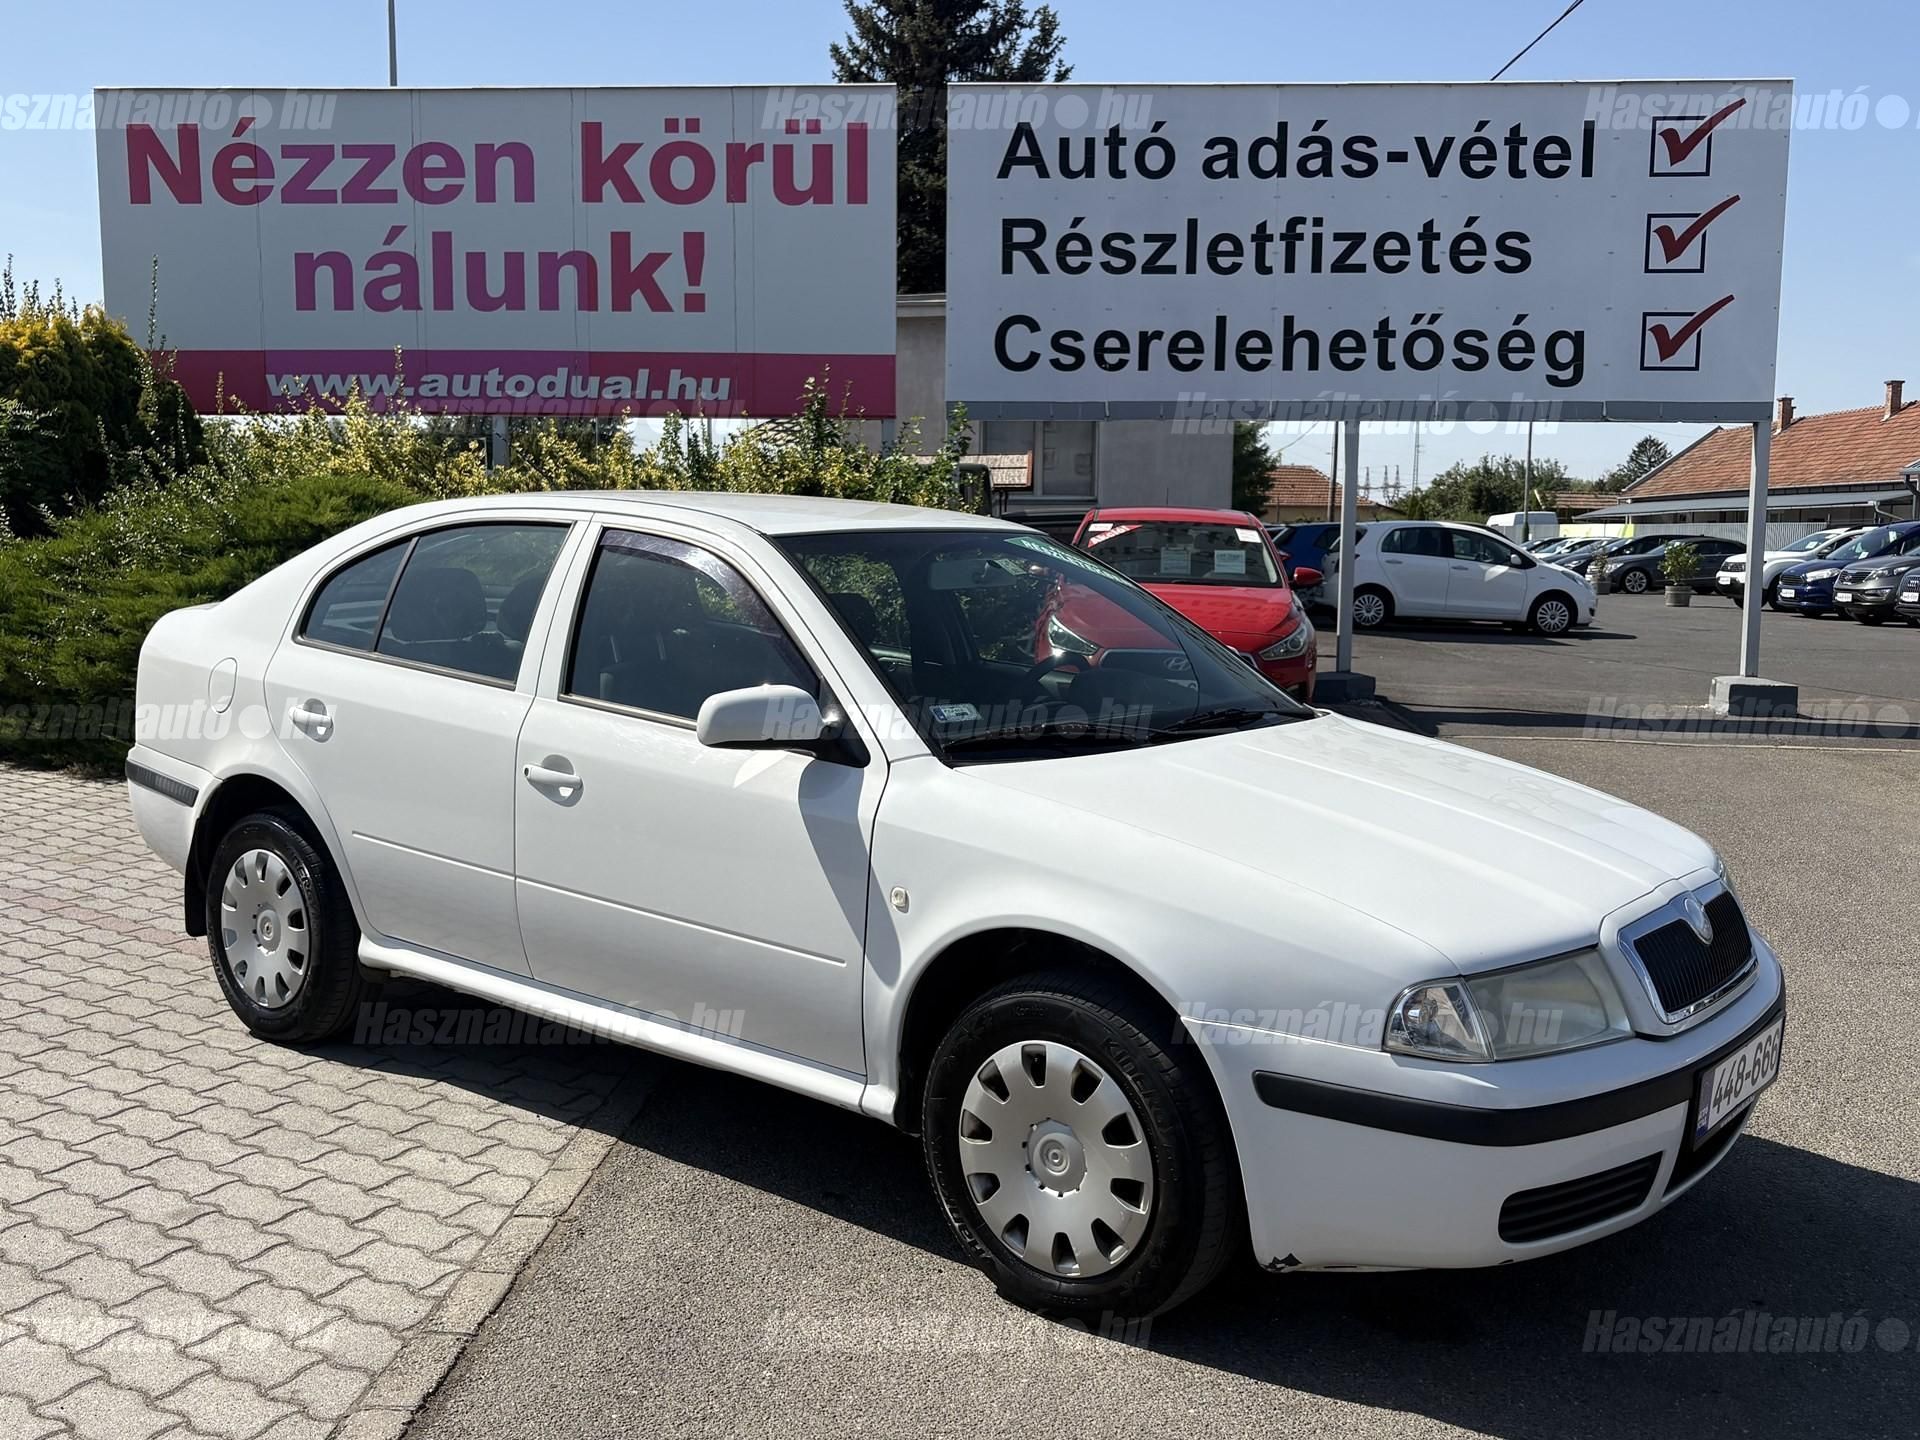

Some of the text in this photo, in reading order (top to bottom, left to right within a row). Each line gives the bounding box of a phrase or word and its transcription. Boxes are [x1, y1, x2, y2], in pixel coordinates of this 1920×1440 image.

[126, 116, 869, 206] Nézzen körül
[996, 118, 1596, 180] Autó adás-vétel
[293, 224, 708, 314] nálunk!
[1001, 214, 1533, 276] Részletfizetés
[993, 311, 1587, 388] Cserelehetőség
[266, 366, 731, 403] www.autodual.hu
